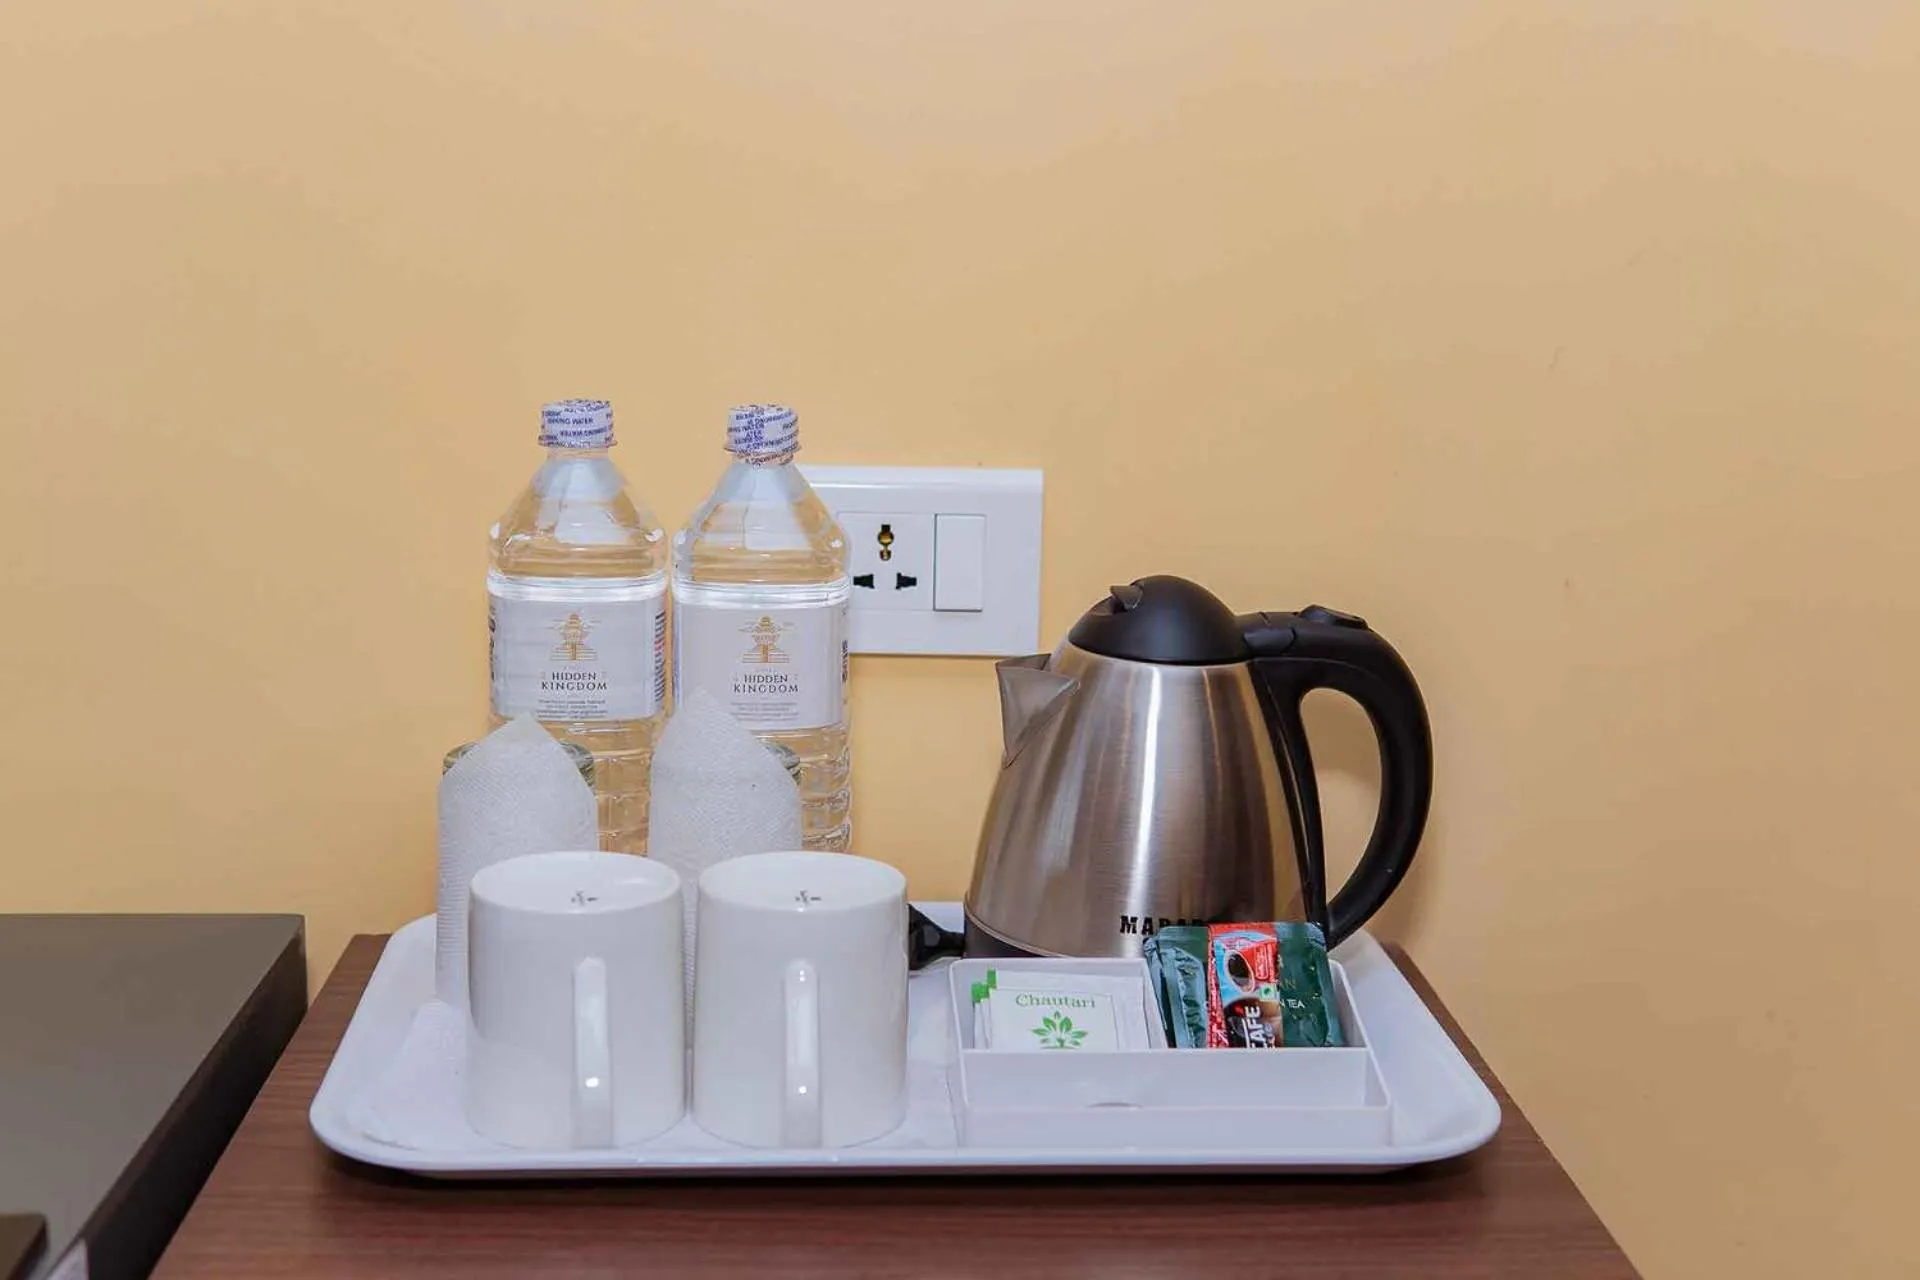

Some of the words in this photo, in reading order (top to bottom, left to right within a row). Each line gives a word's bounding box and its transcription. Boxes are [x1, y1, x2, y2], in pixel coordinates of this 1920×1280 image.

[552, 671, 597, 681] HIDDEN
[744, 674, 788, 683] HIDDEN
[541, 681, 607, 691] KINGDOM
[734, 684, 799, 693] KINGDOM
[1015, 992, 1096, 1009] Chautari
[1287, 998, 1306, 1009] TEA
